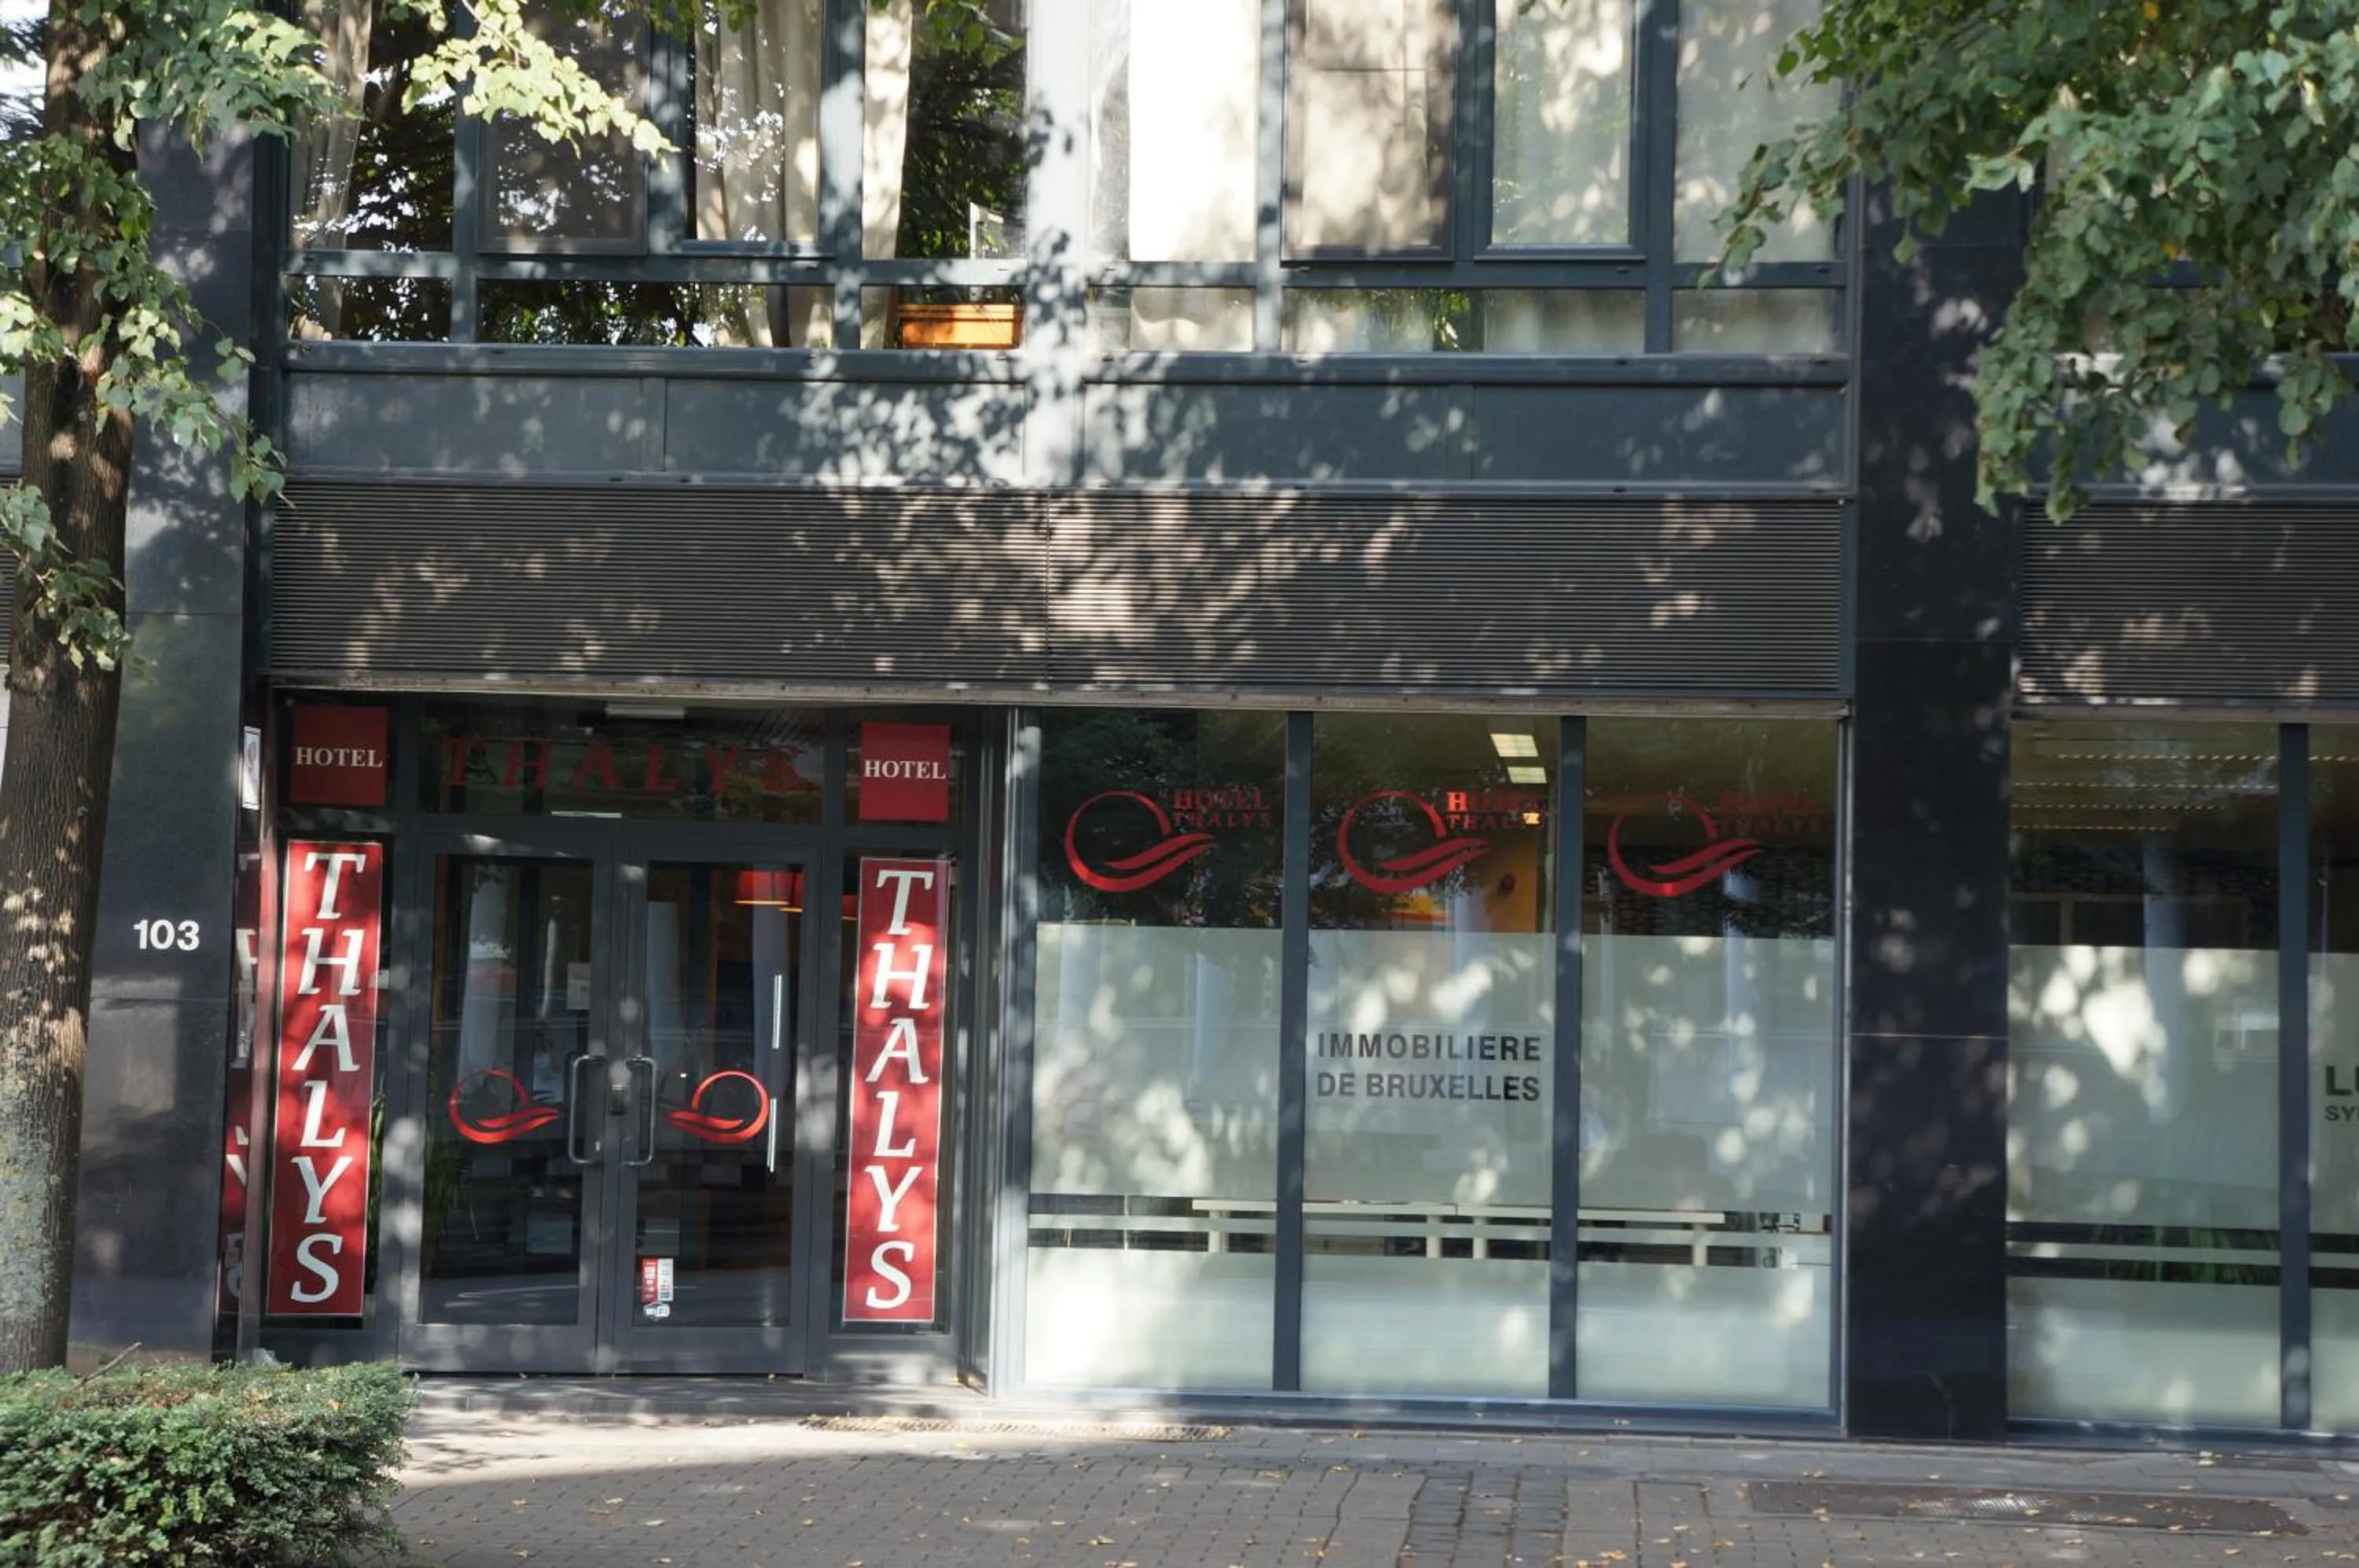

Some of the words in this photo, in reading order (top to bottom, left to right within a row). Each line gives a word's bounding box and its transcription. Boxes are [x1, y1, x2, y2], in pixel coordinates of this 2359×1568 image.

[296, 746, 384, 768] HOTEL
[441, 735, 803, 795] THALYS
[864, 759, 947, 779] HOTEL
[1172, 787, 1272, 810] HOTEL
[1172, 812, 1272, 827] THALYS
[134, 918, 200, 951] 103
[1318, 1032, 1541, 1062] IMMOBILIERE
[291, 851, 365, 1304] THALYS
[866, 869, 934, 1310] THALYS
[1317, 1072, 1355, 1097] DE
[1366, 1073, 1541, 1101] BRUXELLES
